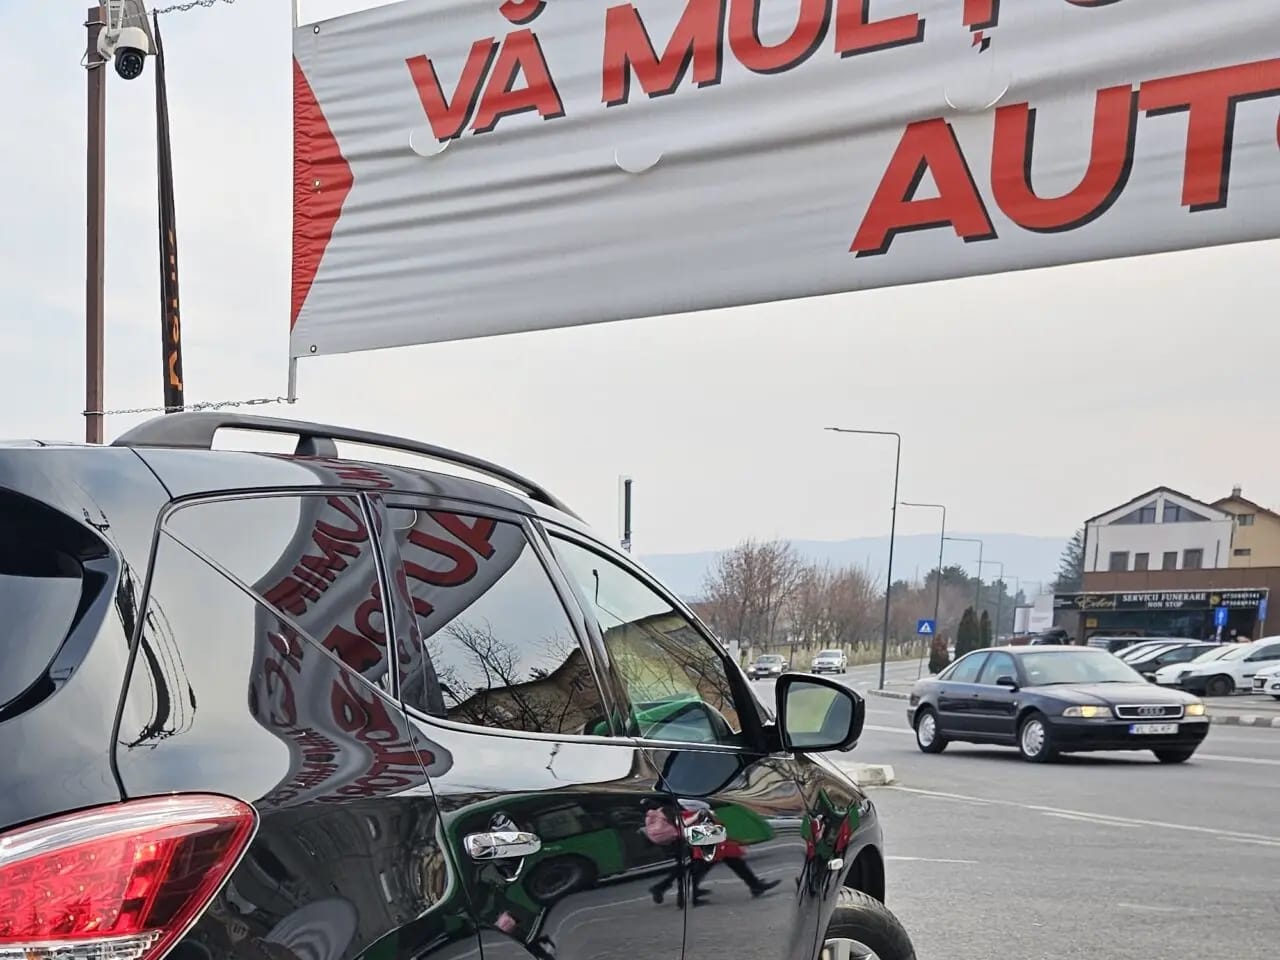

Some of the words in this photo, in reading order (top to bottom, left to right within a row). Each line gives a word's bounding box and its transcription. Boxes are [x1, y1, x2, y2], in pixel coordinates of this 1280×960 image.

[405, 0, 566, 142] VĂ
[849, 58, 1280, 259] AUT
[1122, 594, 1159, 602] SERVICII
[1161, 592, 1206, 601] FUNERARE
